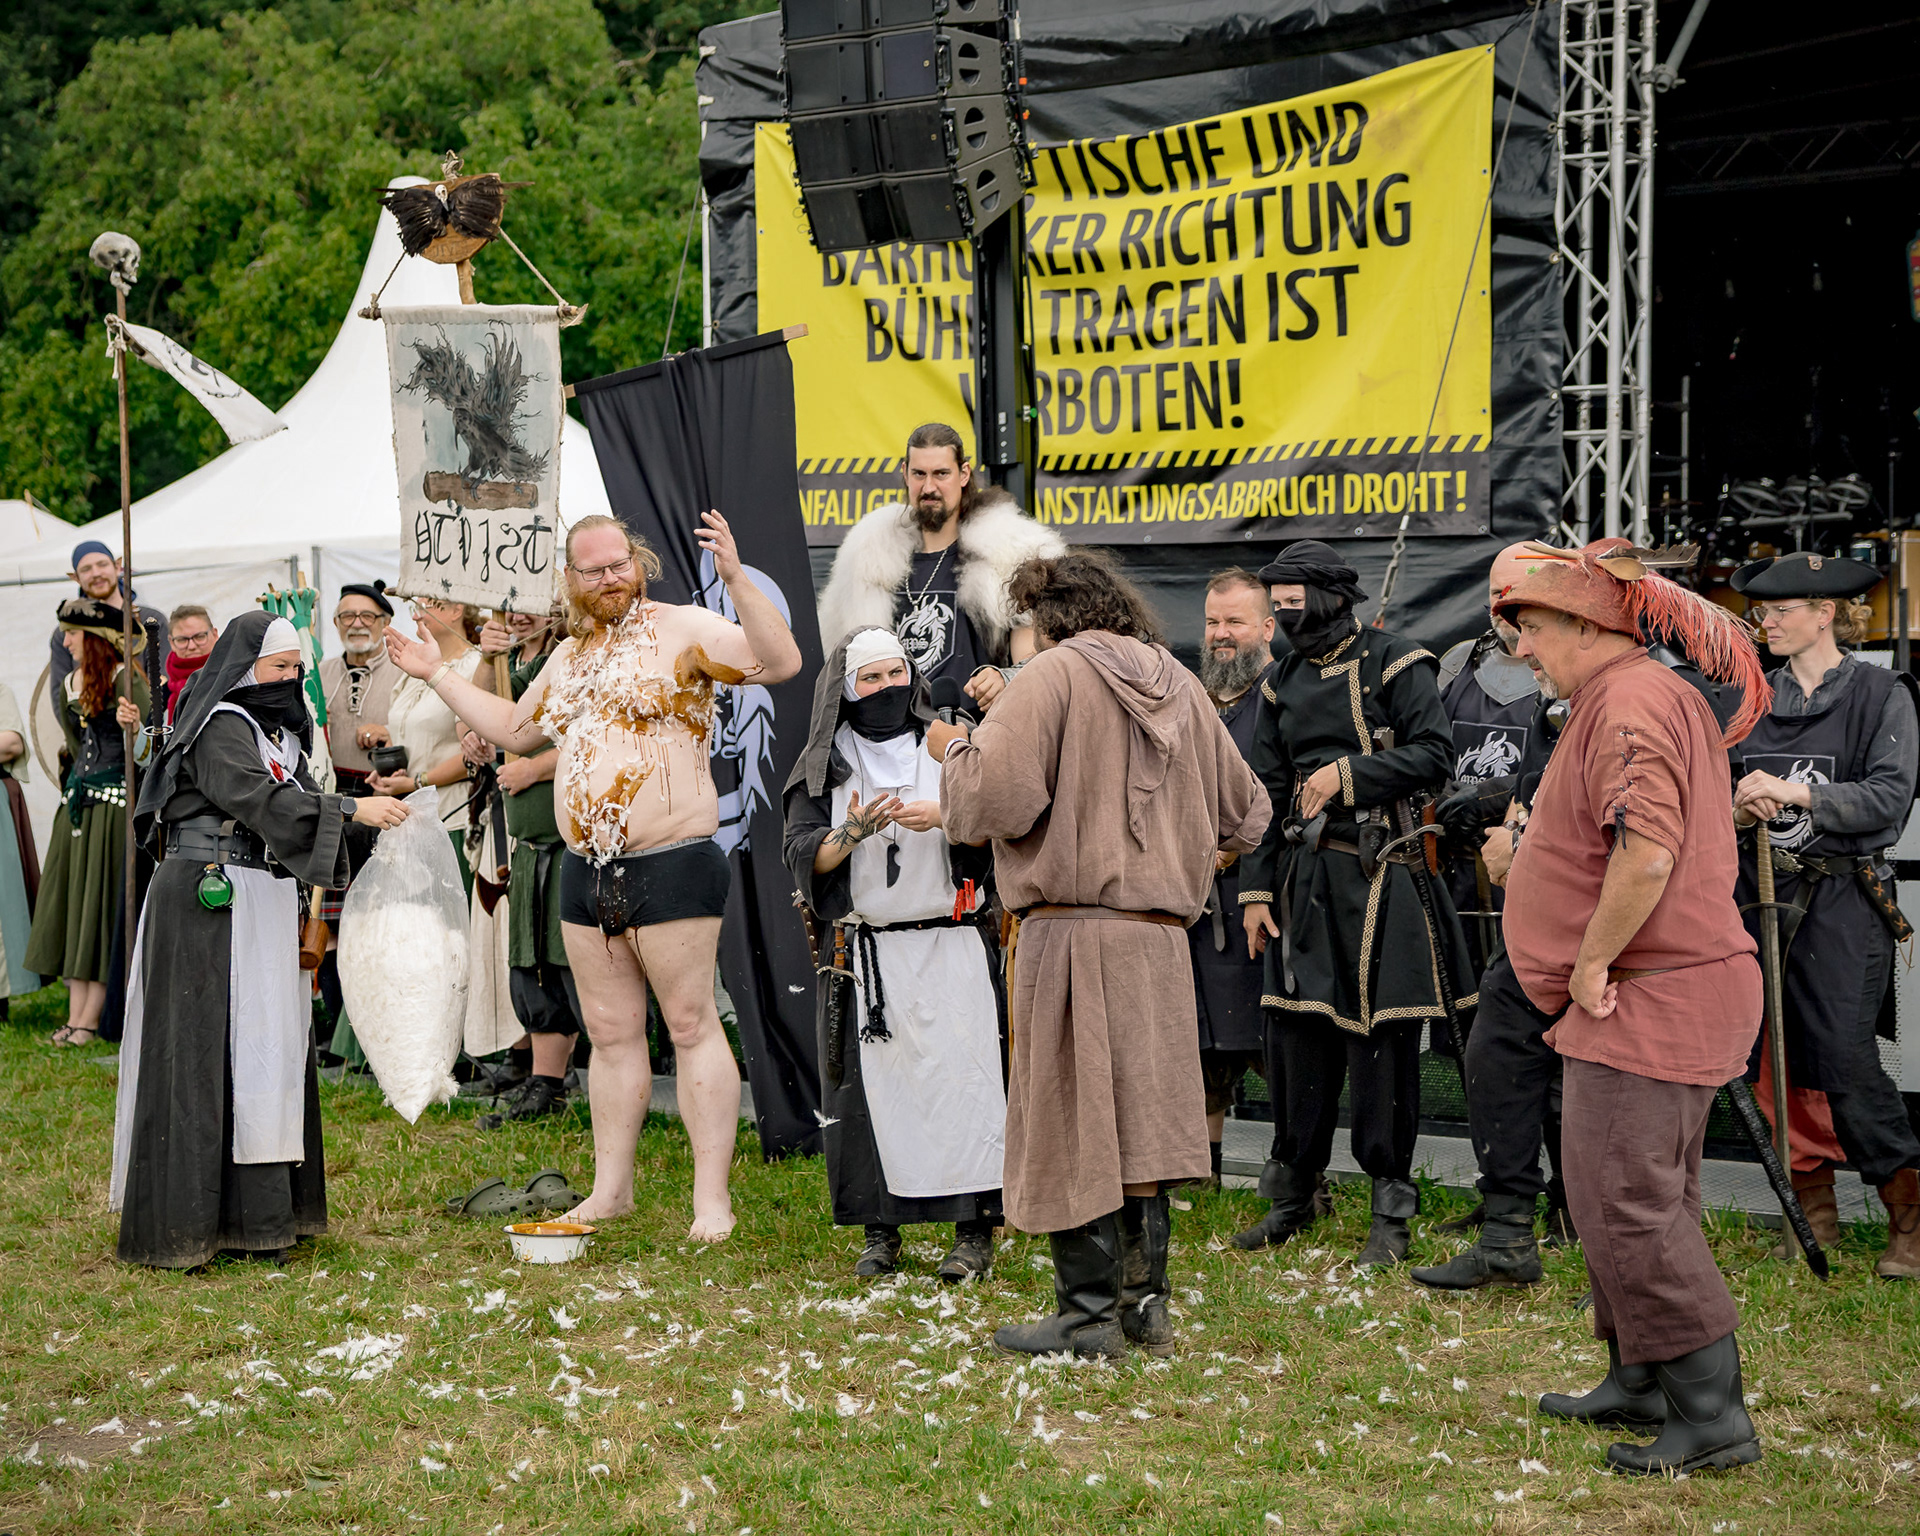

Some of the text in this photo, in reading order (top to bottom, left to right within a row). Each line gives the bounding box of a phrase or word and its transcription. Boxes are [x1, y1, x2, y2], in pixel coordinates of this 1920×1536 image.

[1040, 101, 1370, 202] TISCHE UND
[1119, 172, 1412, 271] RICHTUNG
[863, 263, 1360, 362] BÜH TRAGEN IST
[1034, 474, 1336, 526] NSTALTUNGSABBRUCH
